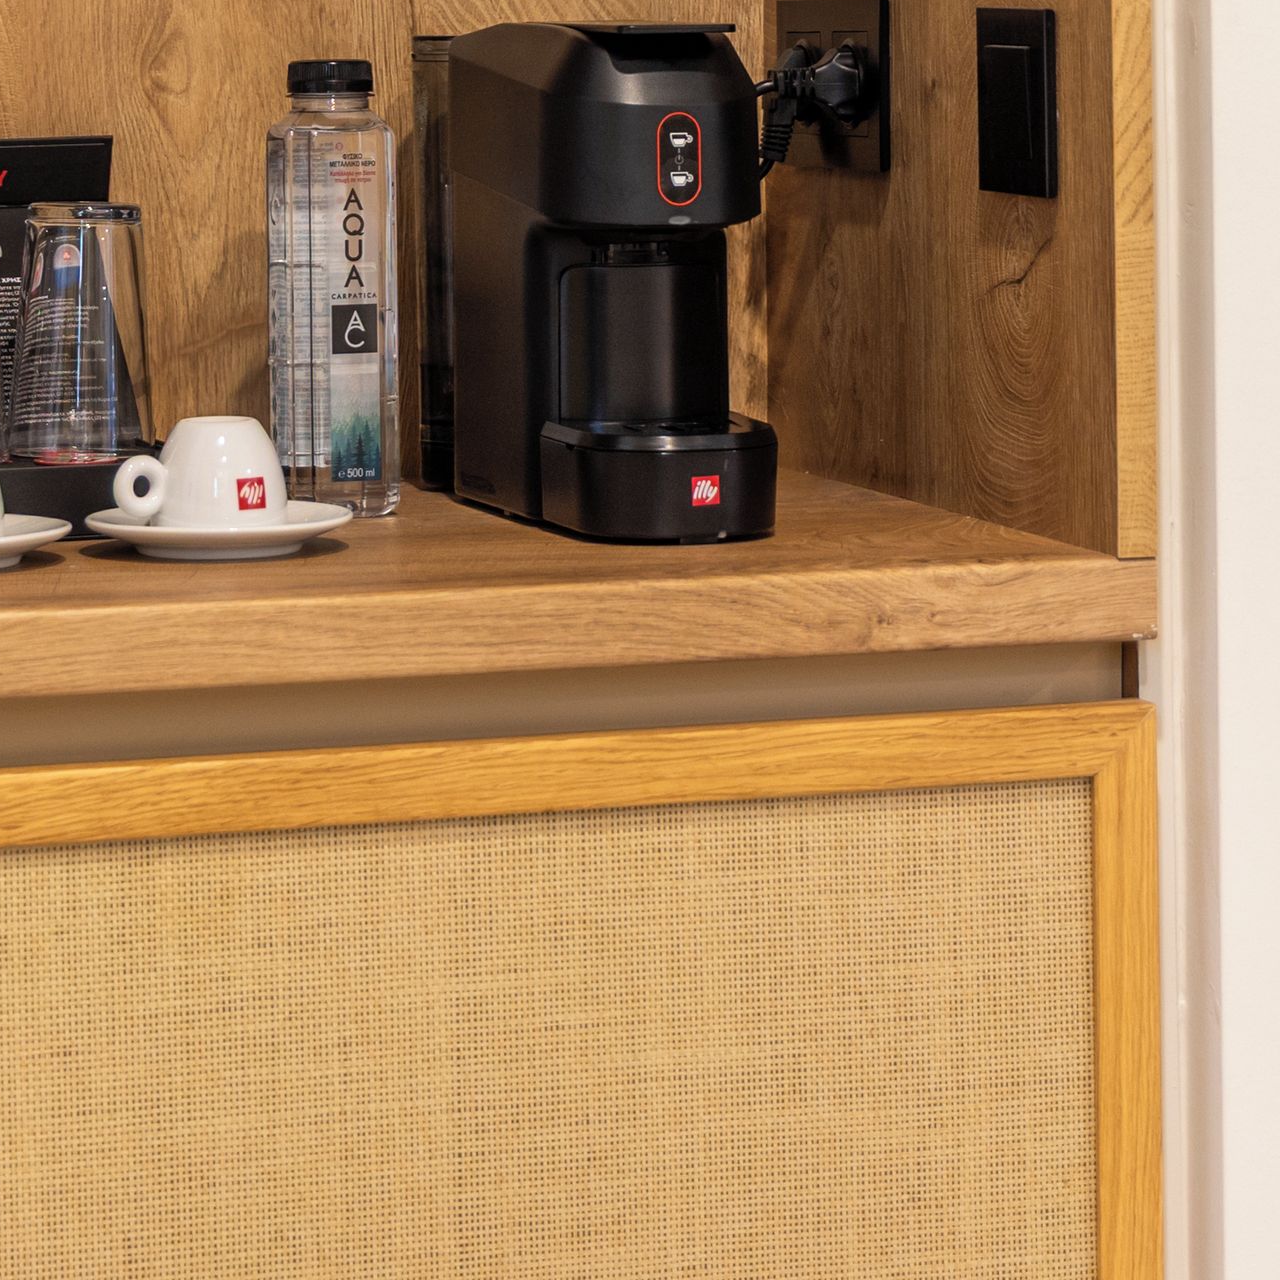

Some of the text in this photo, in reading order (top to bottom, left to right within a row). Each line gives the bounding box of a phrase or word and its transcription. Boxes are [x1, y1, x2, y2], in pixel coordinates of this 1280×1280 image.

[342, 187, 365, 288] AQUA
[331, 292, 377, 300] CARPATICA
[347, 467, 364, 478] 500
[365, 467, 376, 477] ml
[693, 479, 718, 504] illy
